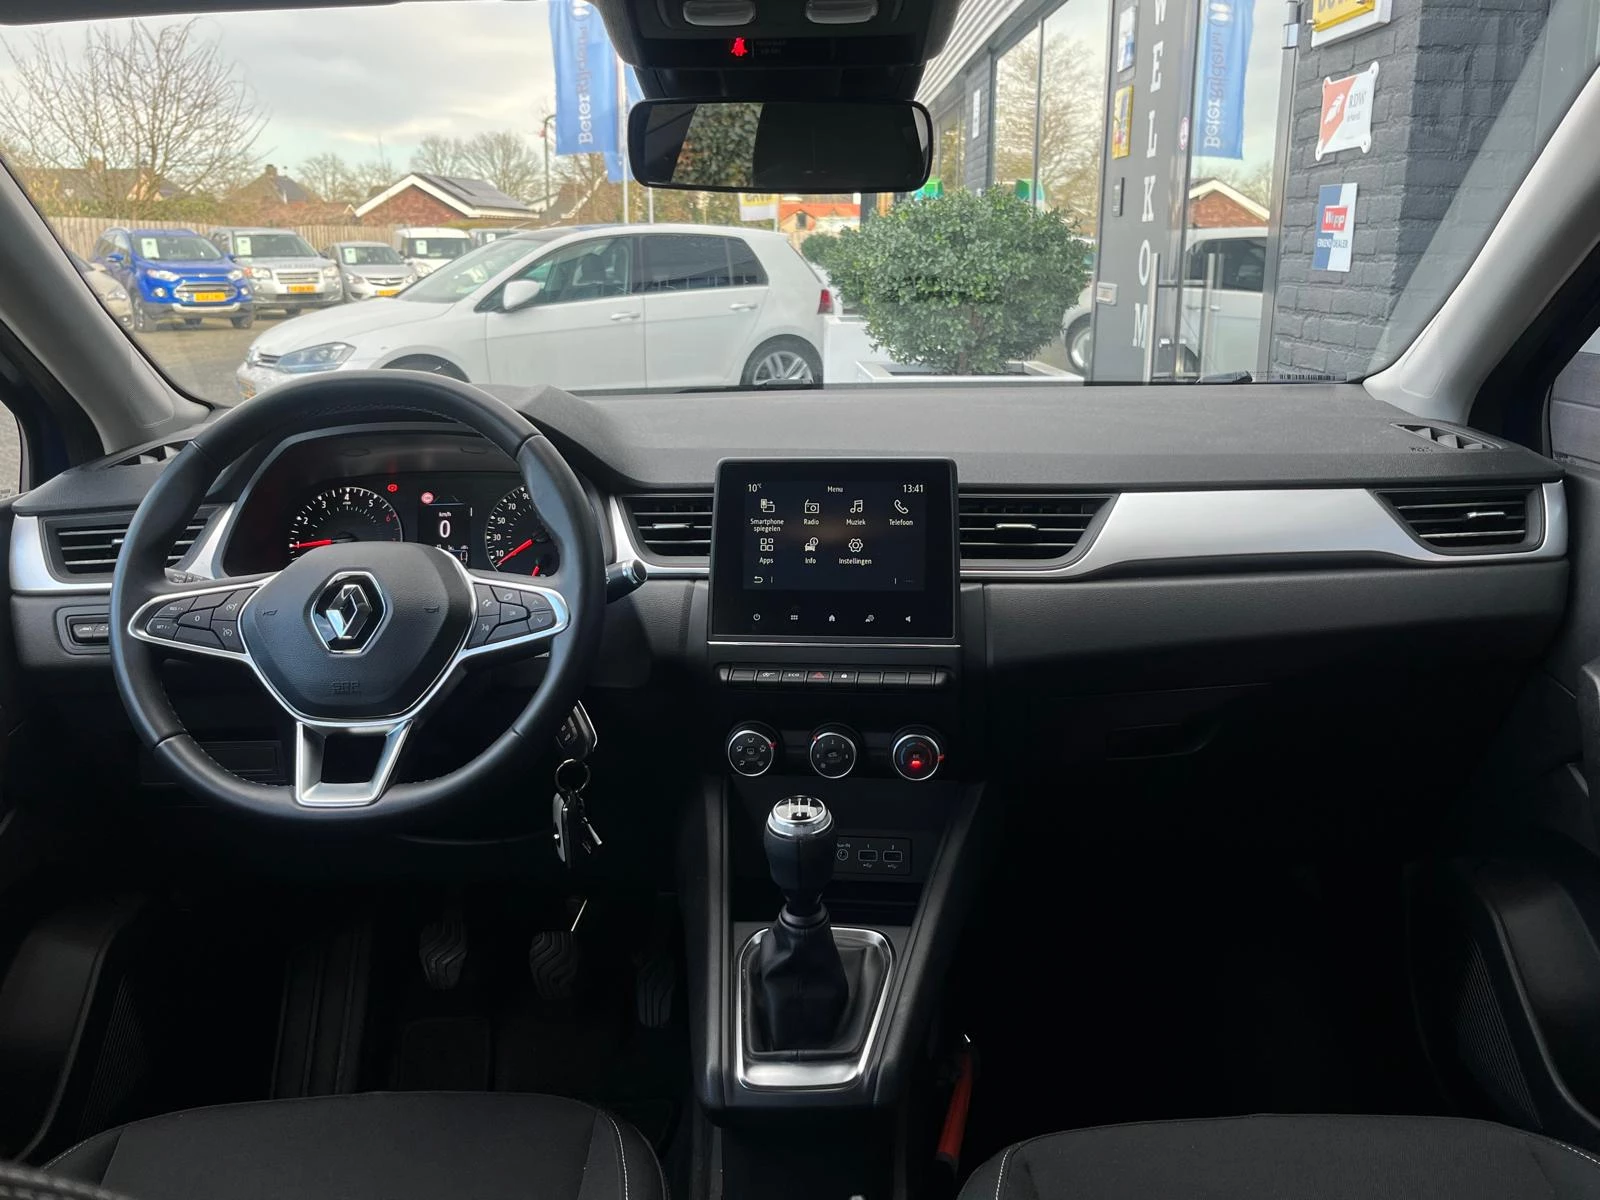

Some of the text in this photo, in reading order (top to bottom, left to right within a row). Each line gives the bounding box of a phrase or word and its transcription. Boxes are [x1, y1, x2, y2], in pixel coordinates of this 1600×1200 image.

[827, 485, 844, 493] Menu
[903, 484, 924, 493] 13:41
[321, 500, 327, 508] 3
[368, 499, 374, 507] 5
[303, 517, 309, 525] 2
[497, 517, 506, 525] 50
[750, 518, 784, 526] Smartphone
[804, 518, 820, 526] Radio
[439, 520, 451, 538] 0
[753, 525, 781, 533] spiegelen
[759, 557, 774, 565] Apps
[838, 557, 872, 566] Instellingen
